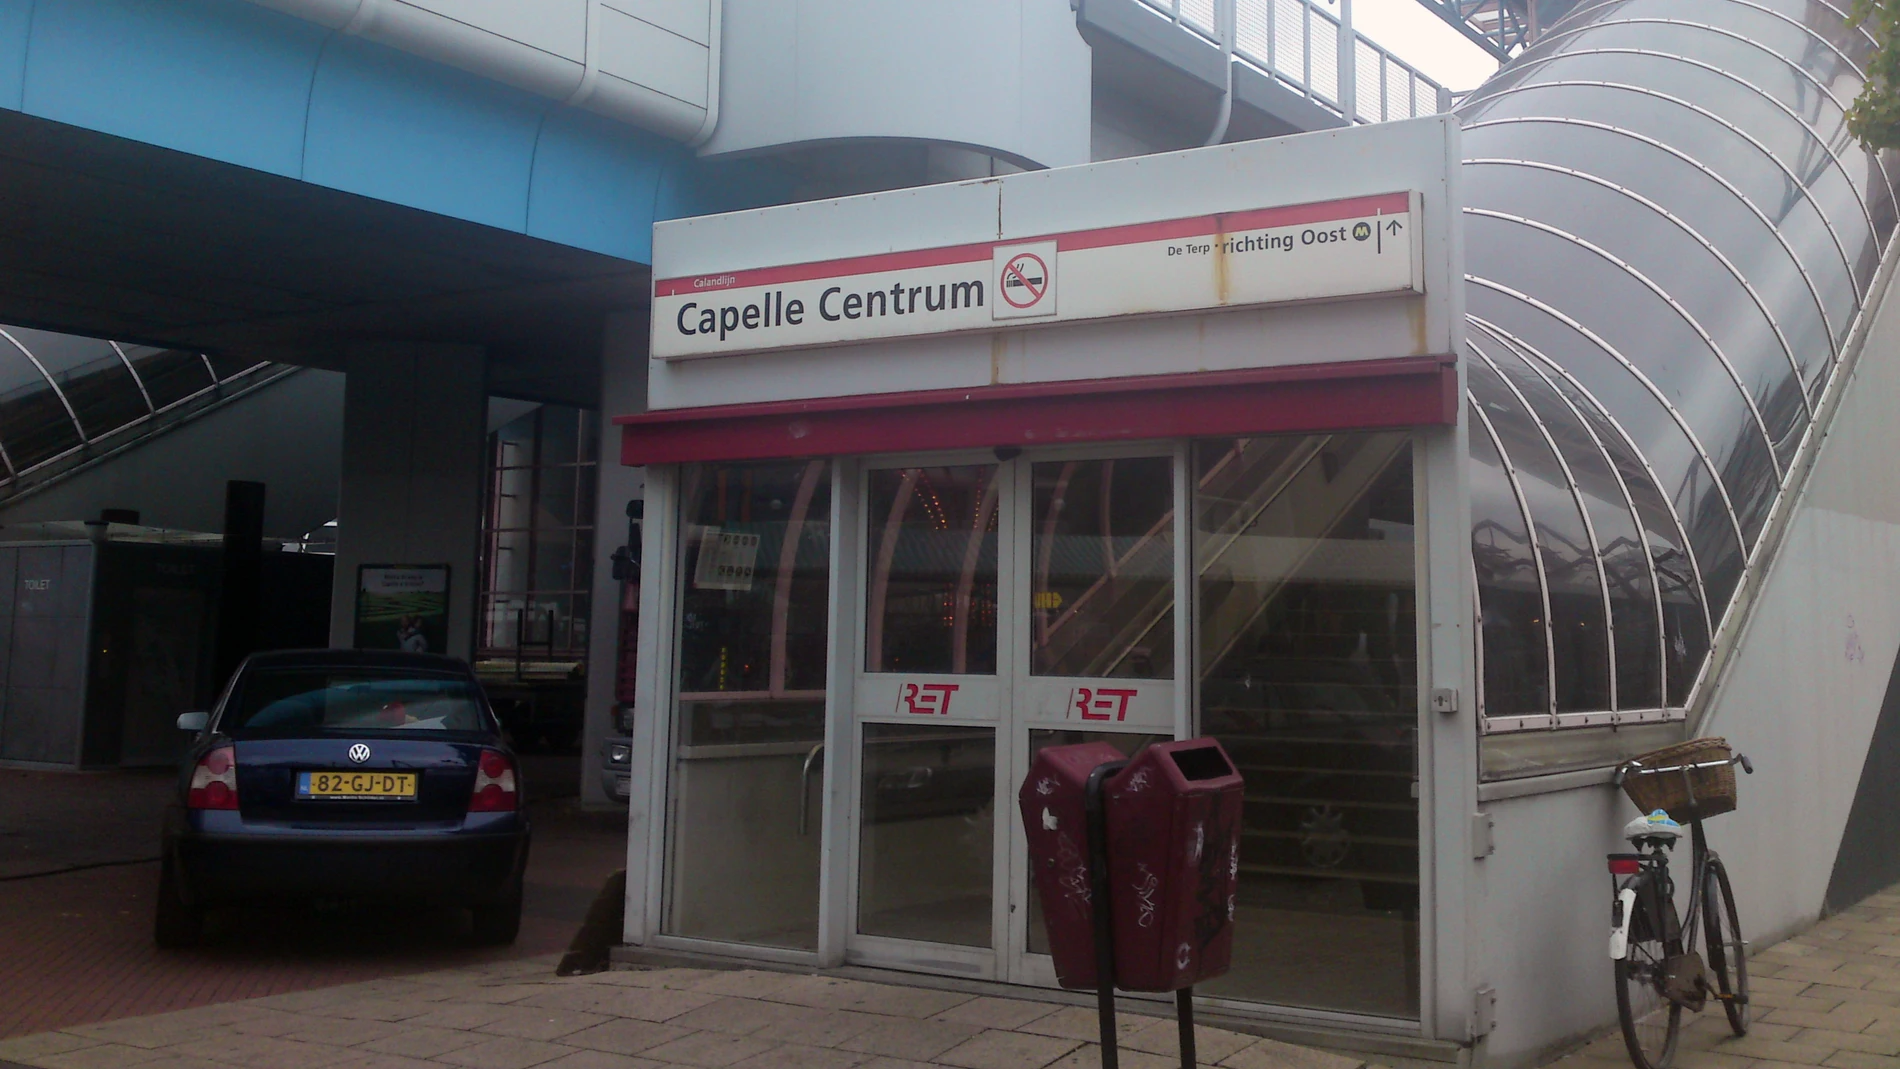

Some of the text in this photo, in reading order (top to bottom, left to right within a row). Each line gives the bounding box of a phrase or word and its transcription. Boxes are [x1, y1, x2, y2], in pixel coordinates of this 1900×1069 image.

[1167, 246, 1183, 256] De
[1186, 243, 1210, 256] Terp
[1222, 233, 1294, 255] richting
[1301, 226, 1347, 245] Oost
[693, 275, 735, 288] Calandlijn
[677, 279, 985, 341] Capelle Centrum
[24, 579, 51, 590] TOILET
[902, 683, 960, 715] RET
[1074, 688, 1138, 722] RET
[317, 775, 408, 793] 82-GJ-DT
